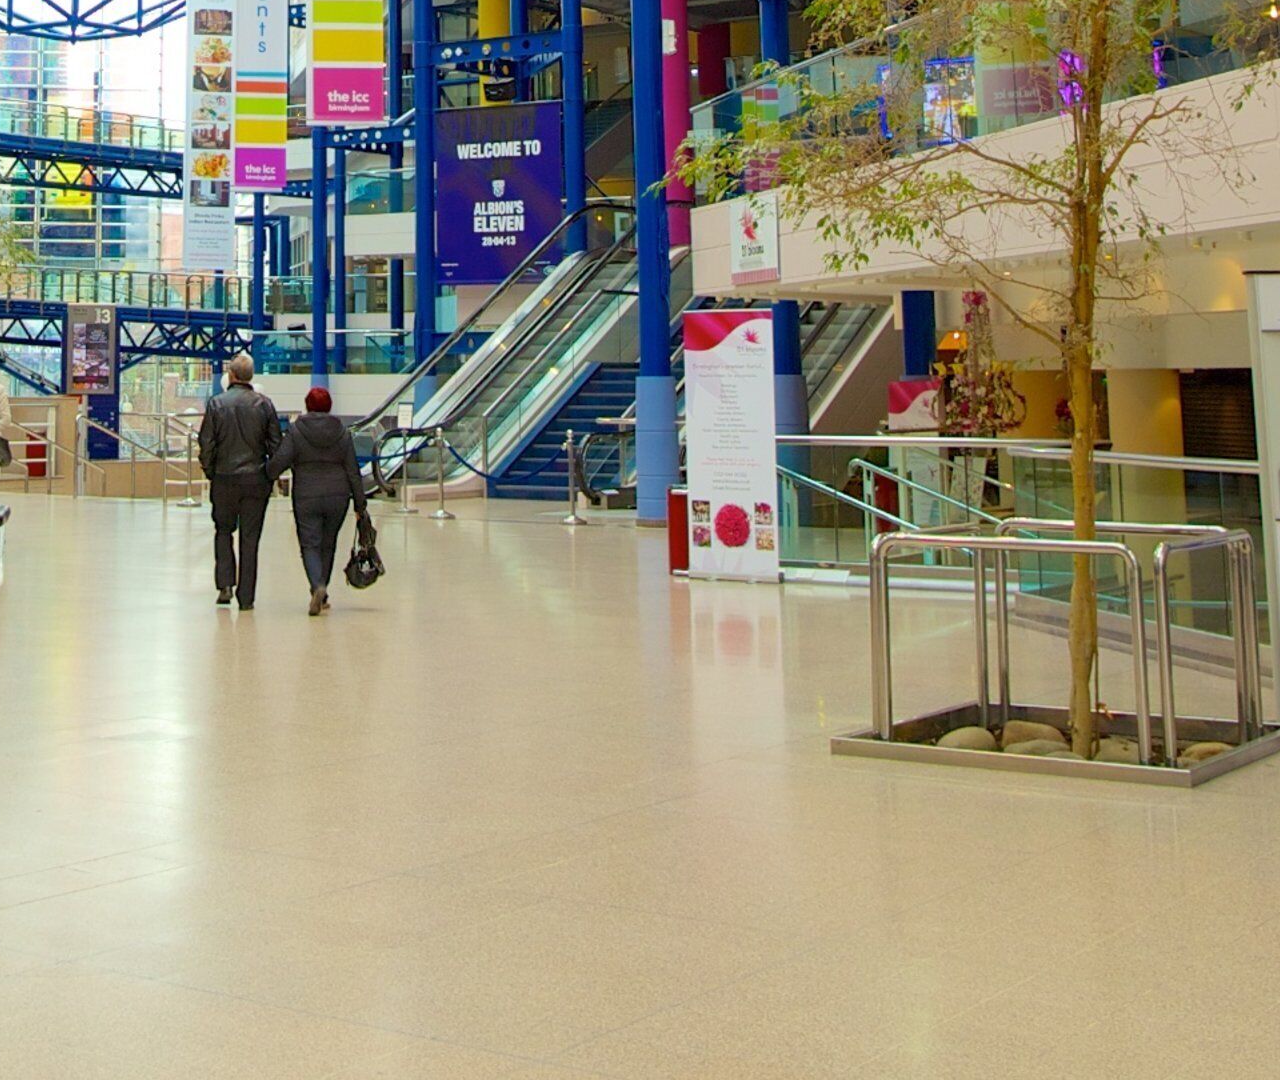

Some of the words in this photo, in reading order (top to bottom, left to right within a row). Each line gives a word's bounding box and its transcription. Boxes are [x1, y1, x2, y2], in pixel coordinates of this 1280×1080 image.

[327, 90, 348, 103] the
[350, 90, 370, 104] icc
[327, 103, 370, 113] birmingham
[457, 141, 522, 160] WELCOME
[523, 139, 541, 156] TO
[244, 164, 262, 175] the
[263, 164, 276, 176] icc
[473, 200, 524, 216] ALBION'S
[473, 215, 525, 233] ELEVEN
[94, 308, 111, 324] 13
